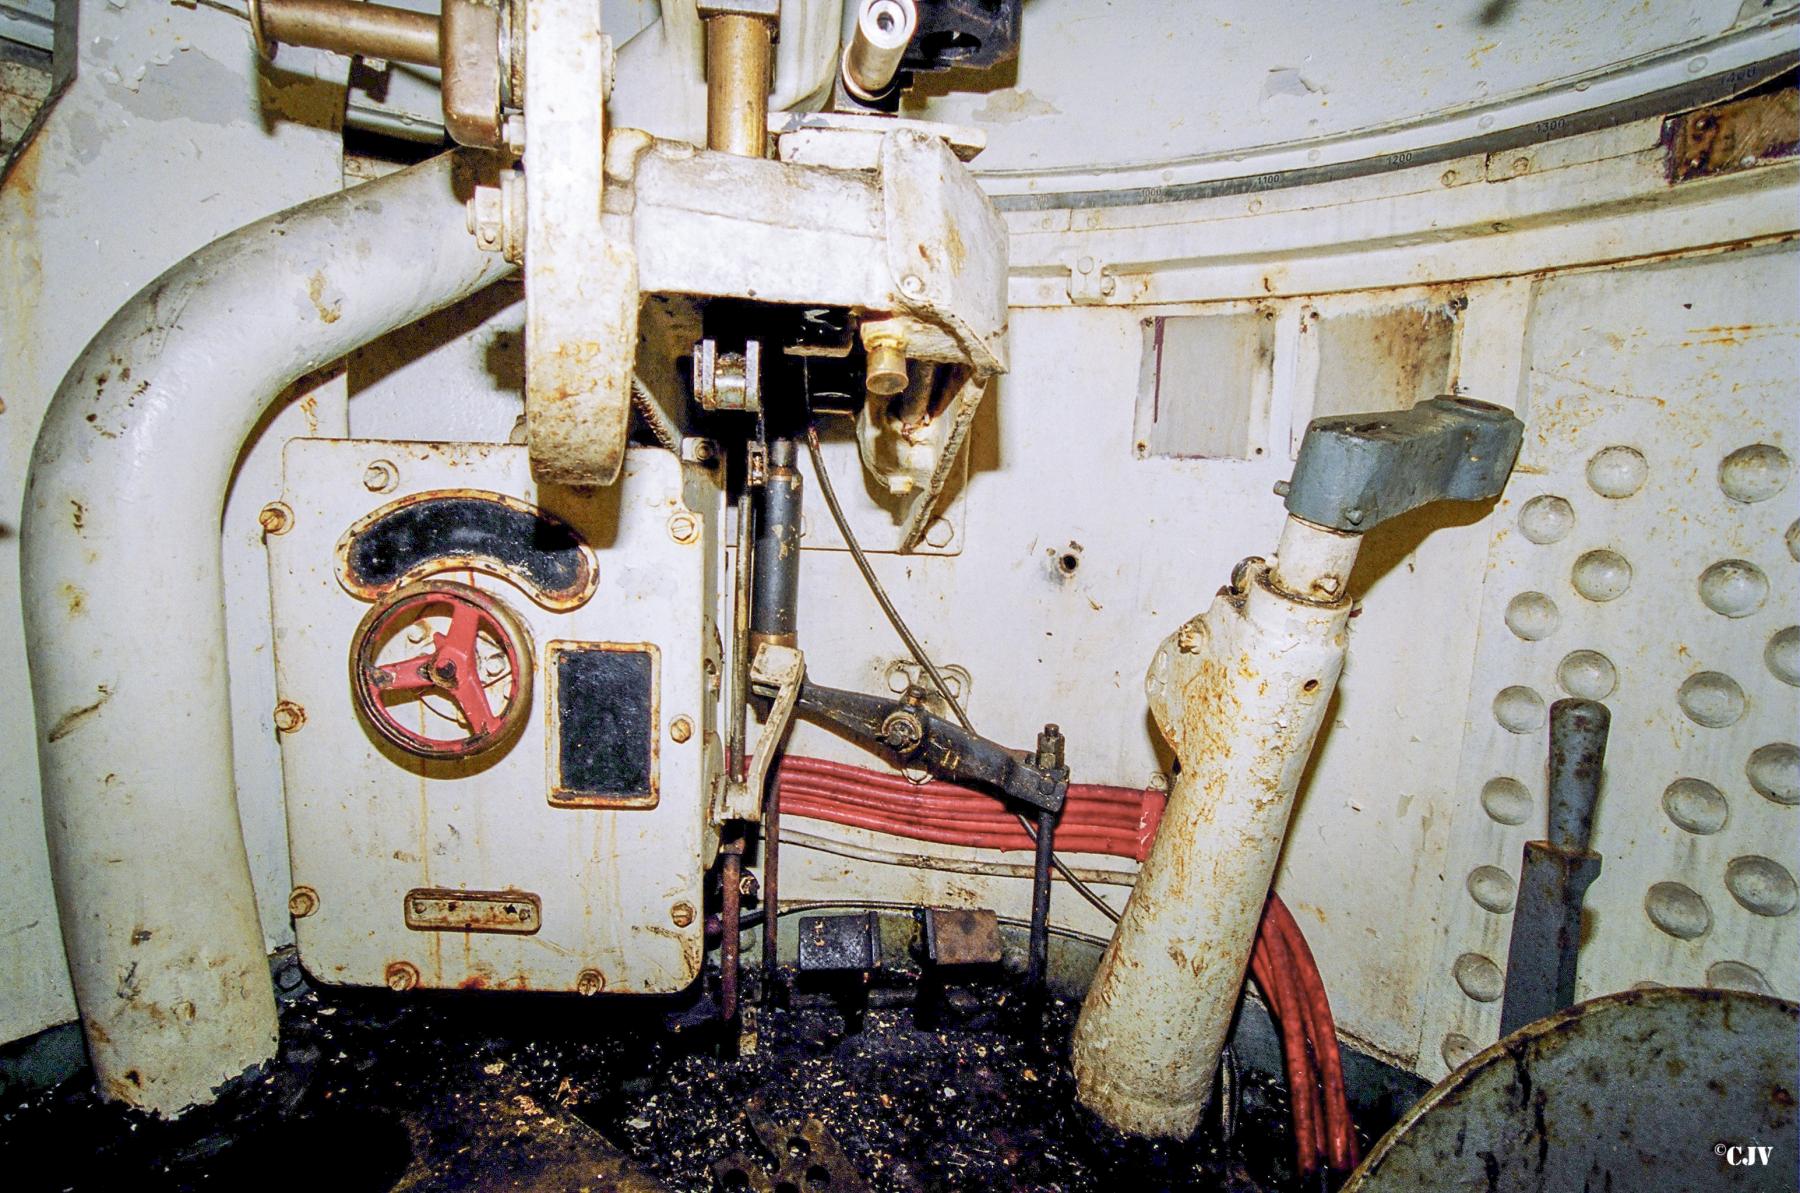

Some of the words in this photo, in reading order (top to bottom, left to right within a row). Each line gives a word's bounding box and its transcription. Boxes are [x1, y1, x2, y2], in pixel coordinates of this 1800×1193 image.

[1536, 118, 1565, 133] 1300
[1386, 152, 1412, 165] 1200
[1257, 174, 1280, 184] 1100
